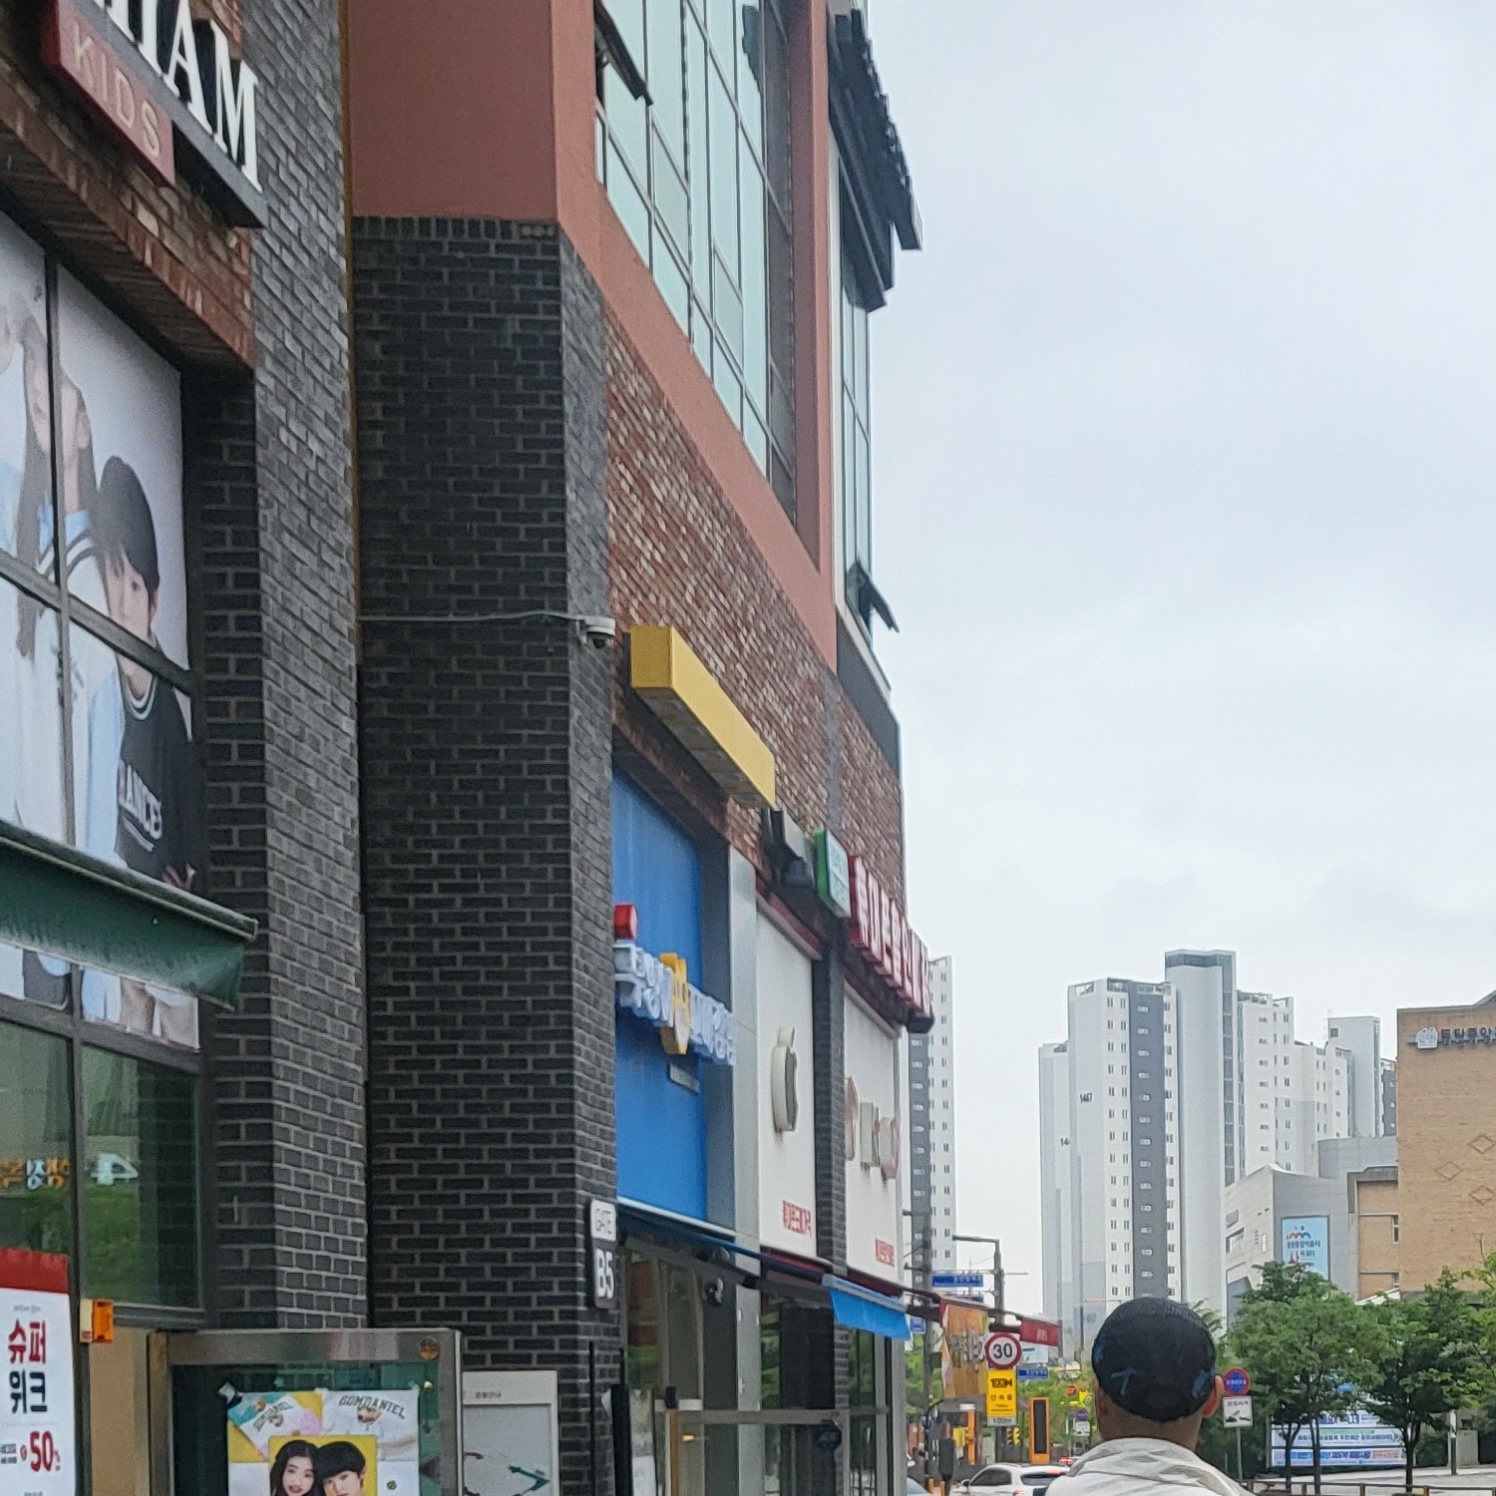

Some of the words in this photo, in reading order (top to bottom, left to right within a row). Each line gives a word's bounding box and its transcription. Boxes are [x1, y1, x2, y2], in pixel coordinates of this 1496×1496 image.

[73, 19, 160, 158] KIDS
[593, 1248, 615, 1299] B5
[8, 1318, 47, 1365] 슈퍼
[992, 1342, 1013, 1360] 30
[9, 1369, 49, 1414] 위크
